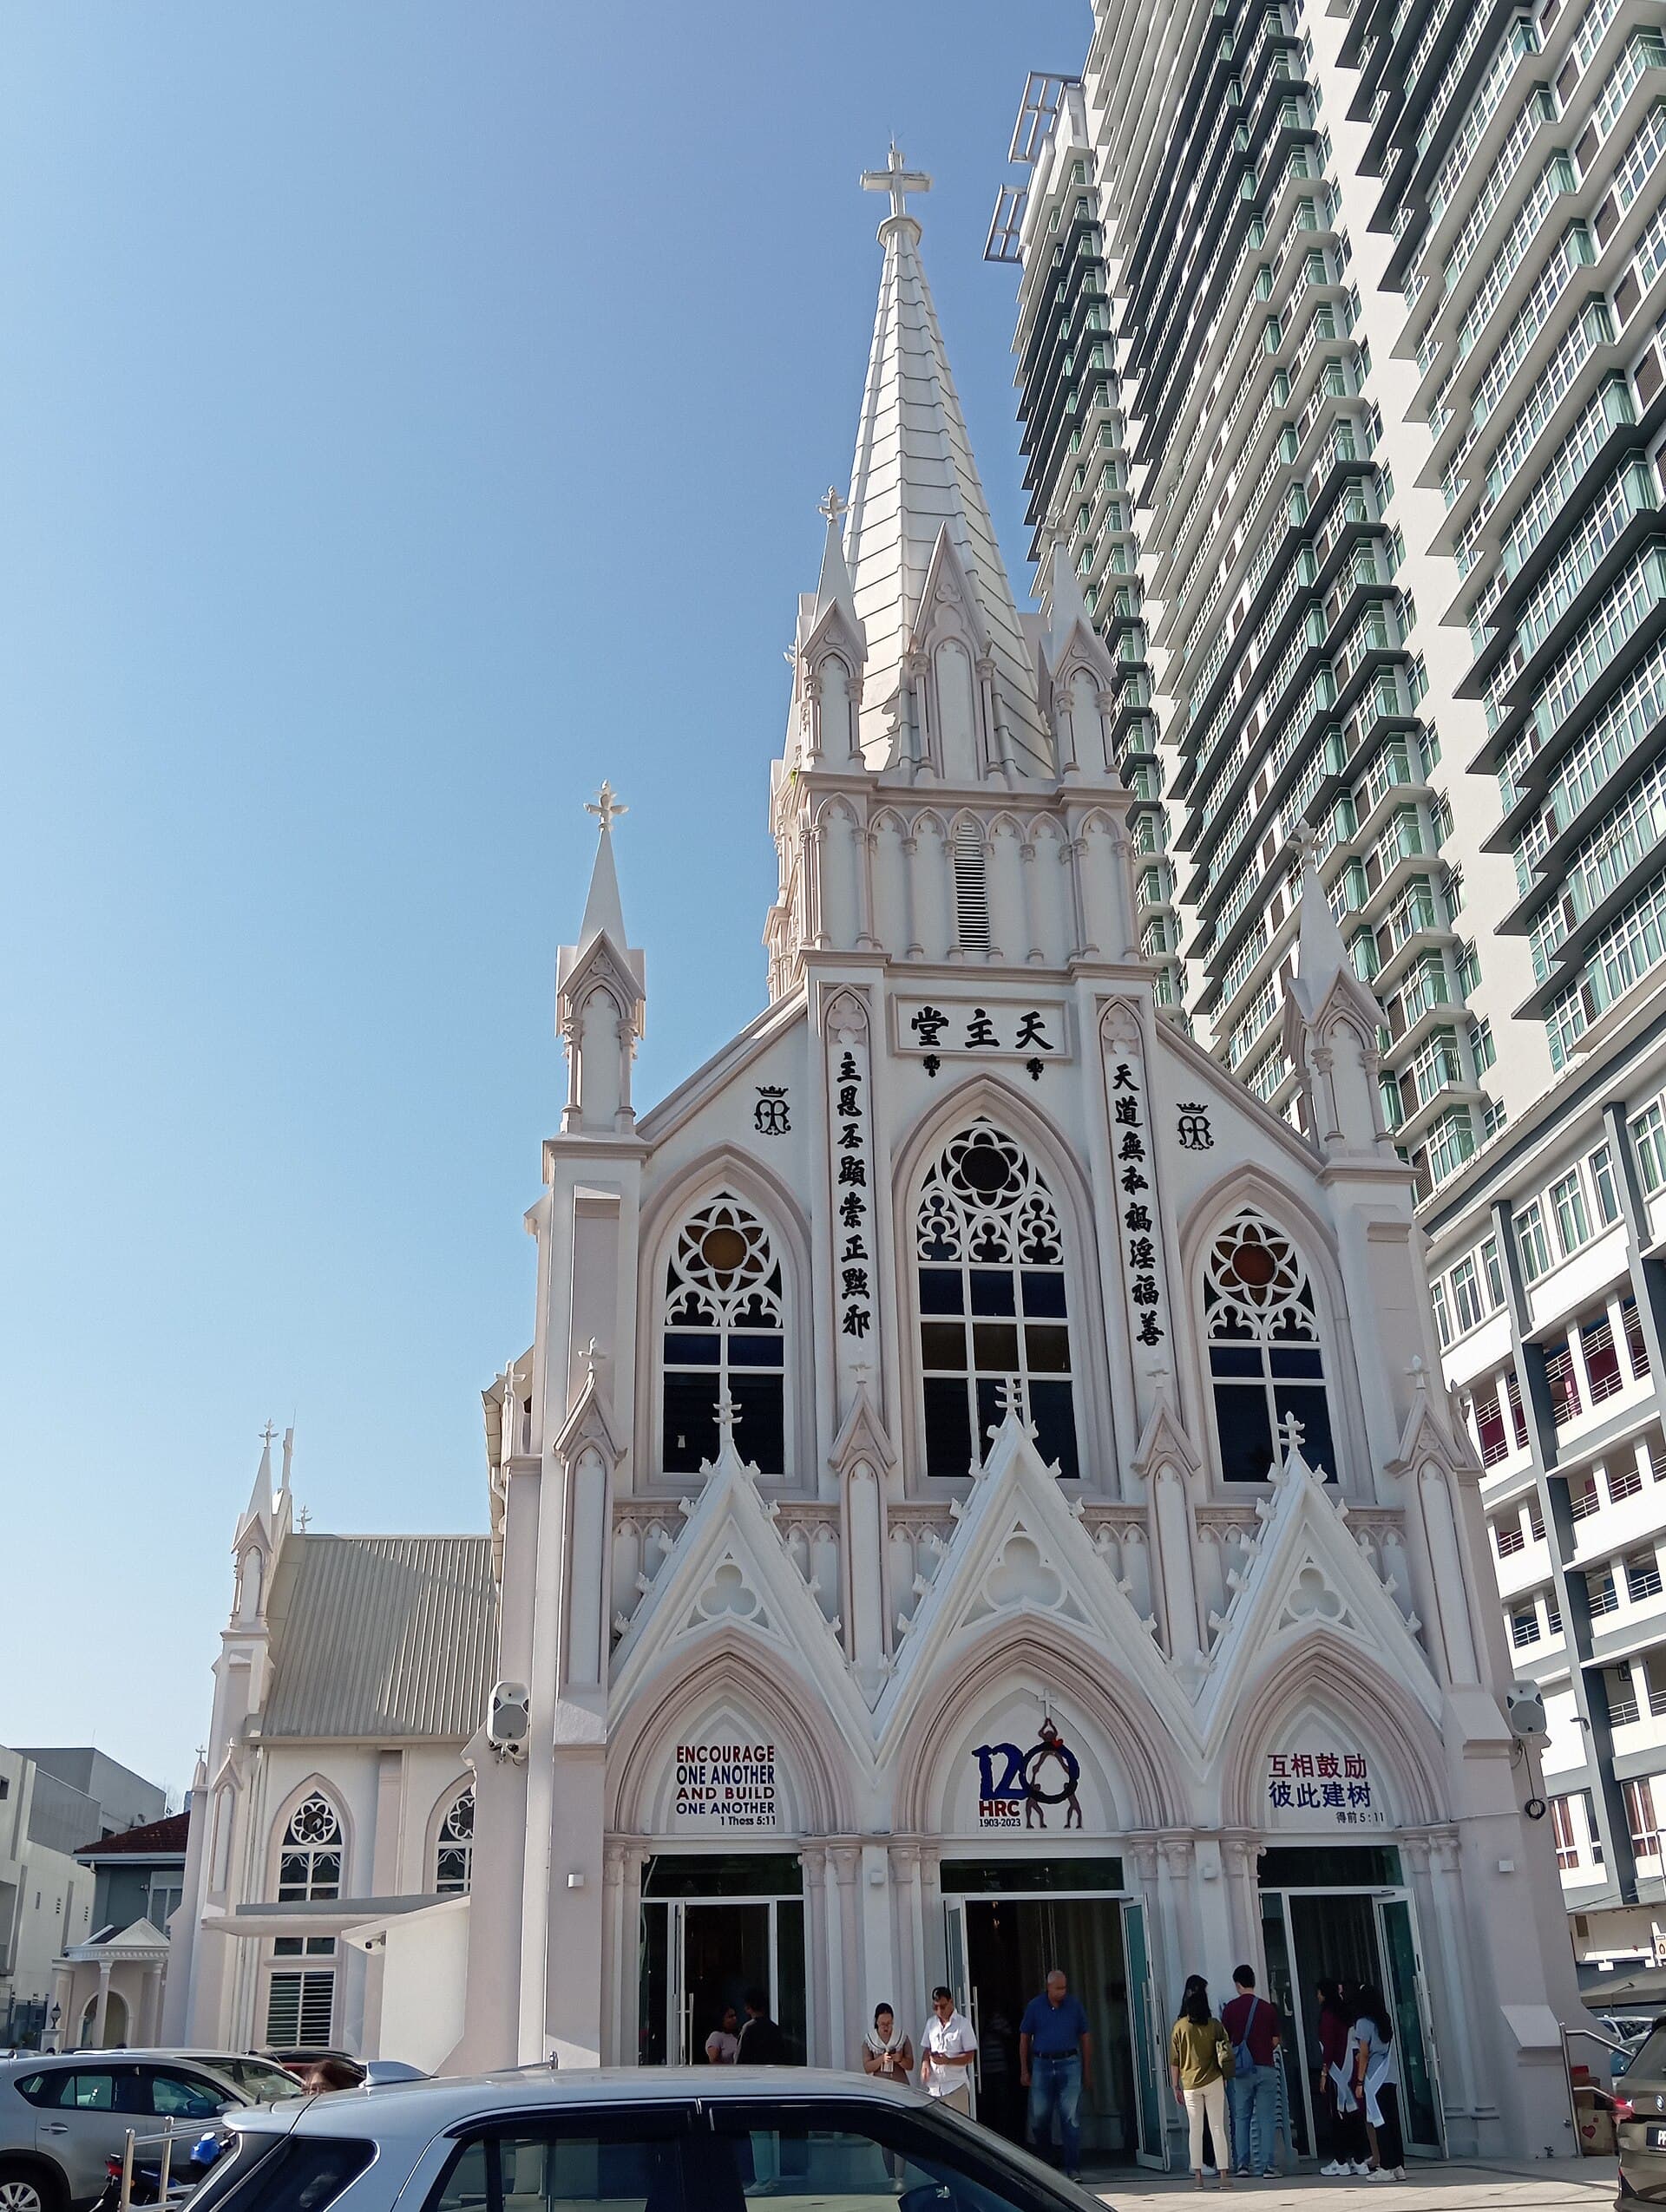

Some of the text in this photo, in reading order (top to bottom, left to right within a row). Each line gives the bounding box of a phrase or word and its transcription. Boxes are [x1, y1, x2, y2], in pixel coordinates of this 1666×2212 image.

[677, 1745, 775, 1763] ENCOURAGE
[1268, 1752, 1368, 1778] 互相鼓励
[677, 1764, 775, 1784] ONE ANOTHER
[677, 1787, 775, 1800] AND BUILD
[1268, 1781, 1371, 1808] 彼此建树
[677, 1802, 775, 1814] ONE ANOTHER
[979, 1801, 1020, 1817] HRC
[721, 1816, 776, 1825] 1 Thess 5:11
[979, 1818, 1021, 1827] 1903-2023
